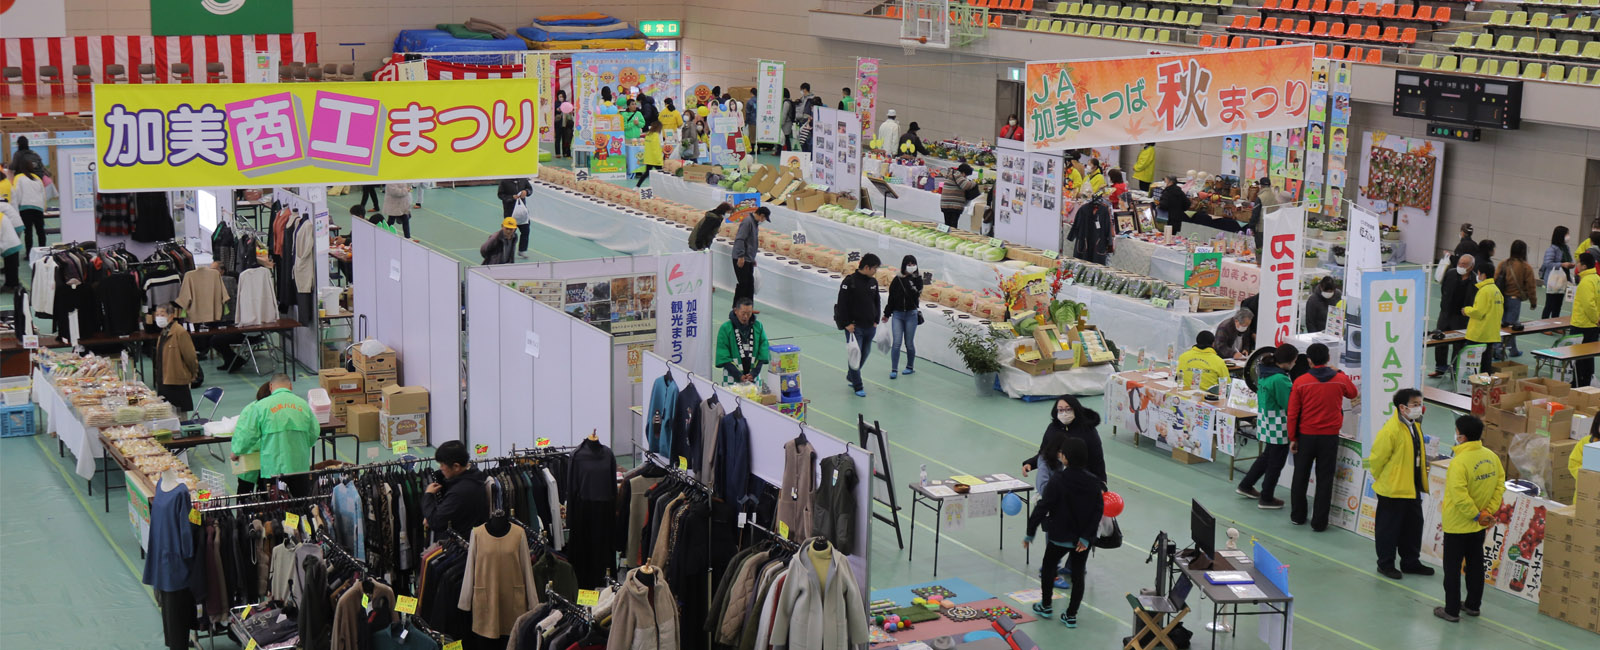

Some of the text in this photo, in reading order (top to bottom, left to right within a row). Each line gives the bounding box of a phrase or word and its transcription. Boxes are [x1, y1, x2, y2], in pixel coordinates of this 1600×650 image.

[643, 24, 677, 33] 非常口
[1031, 78, 1148, 142] 加美よつば
[1033, 70, 1075, 103] JA
[103, 98, 535, 168] 加美商工まつり
[671, 300, 684, 365] 観光まちづ
[685, 299, 698, 338] 加美町
